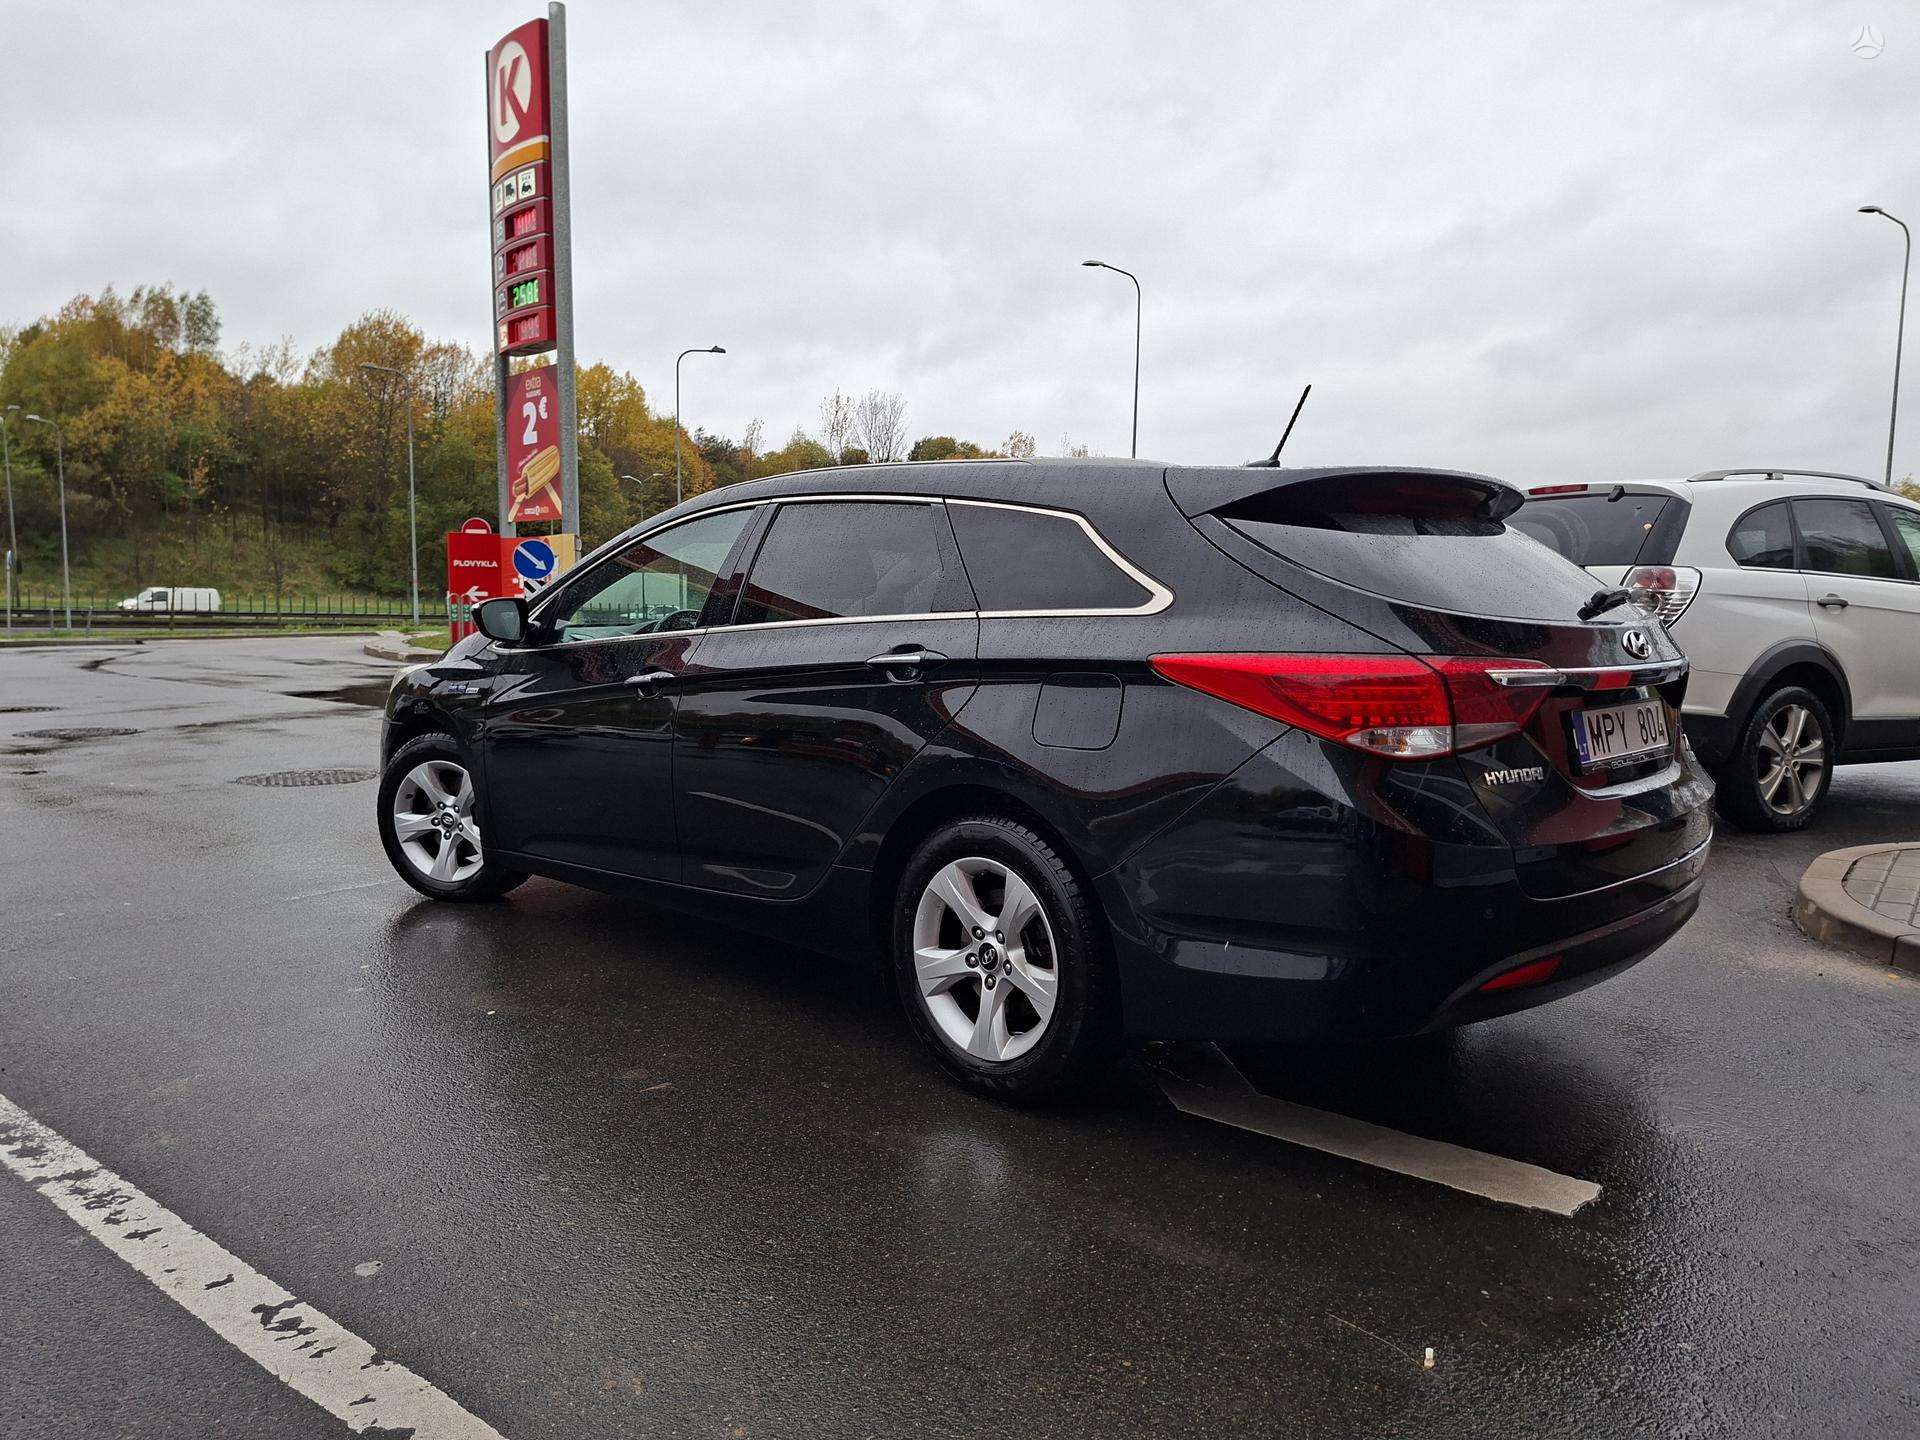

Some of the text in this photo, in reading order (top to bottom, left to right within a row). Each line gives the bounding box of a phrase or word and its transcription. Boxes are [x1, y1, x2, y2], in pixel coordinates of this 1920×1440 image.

[497, 50, 530, 136] K
[453, 559, 498, 568] PLOVYKLA
[1587, 706, 1666, 756] MPY 804
[1578, 743, 1588, 755] LT
[1484, 767, 1544, 786] HYUNDAI
